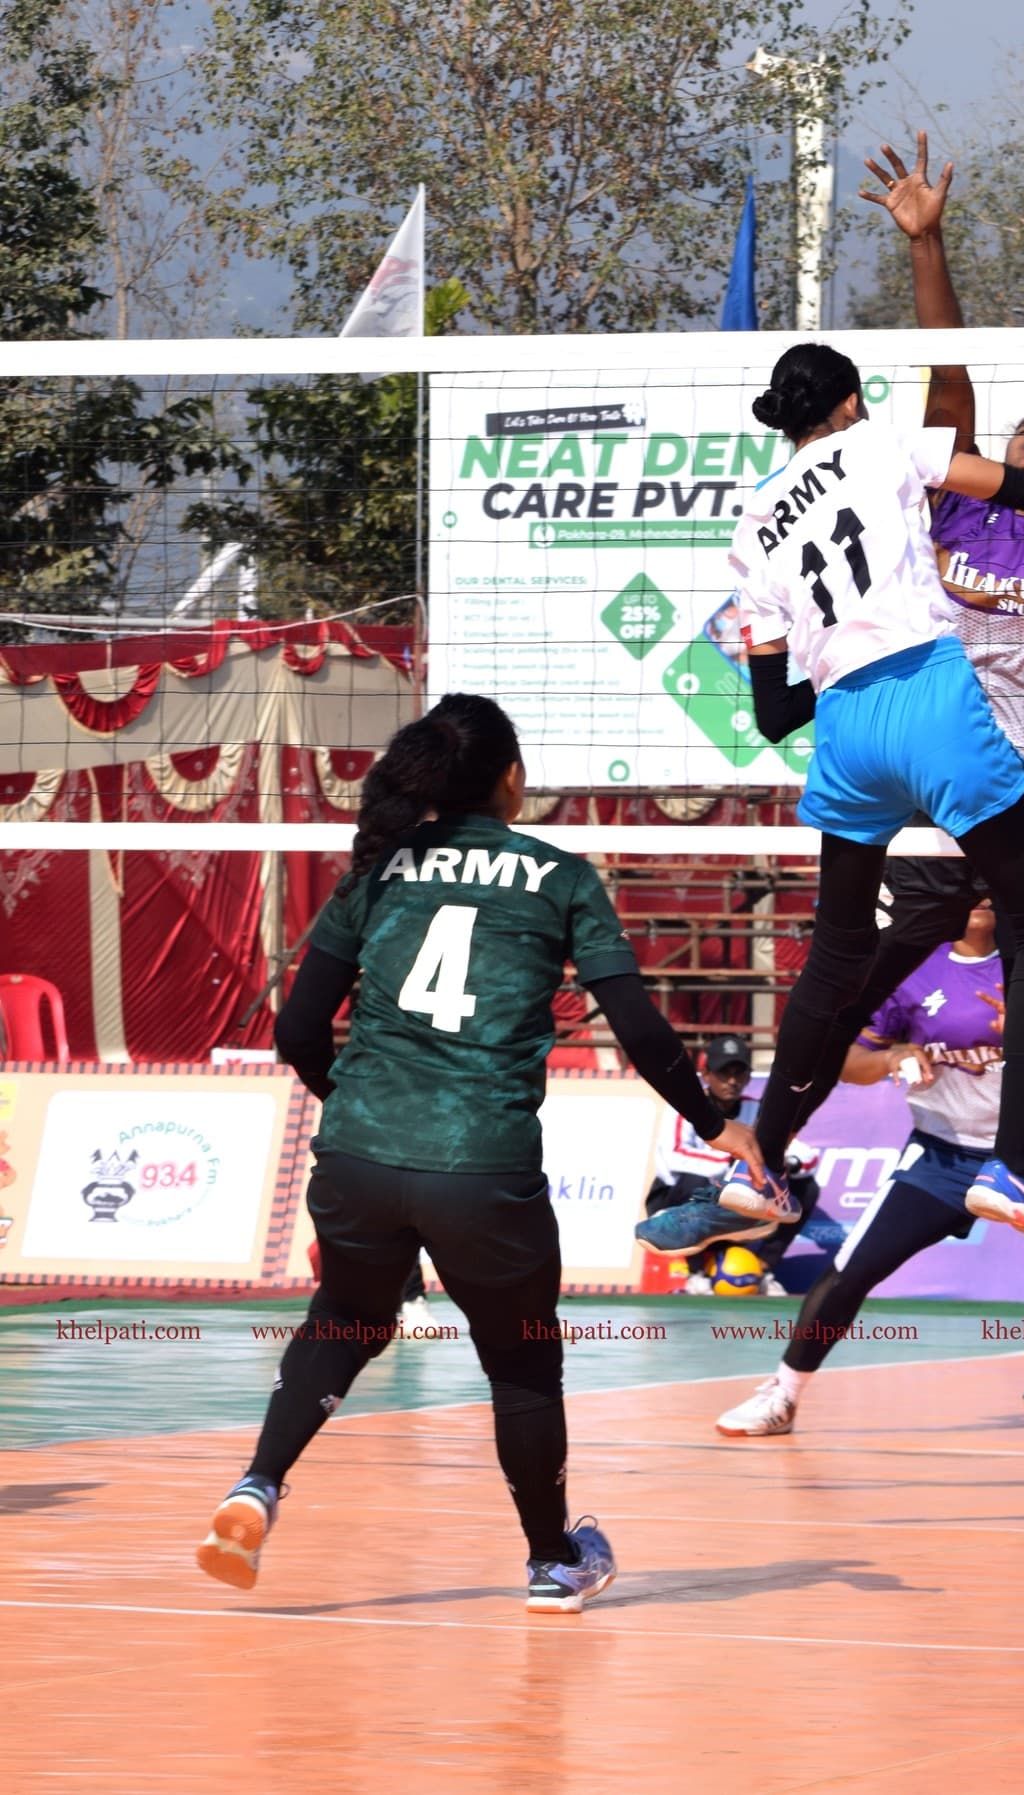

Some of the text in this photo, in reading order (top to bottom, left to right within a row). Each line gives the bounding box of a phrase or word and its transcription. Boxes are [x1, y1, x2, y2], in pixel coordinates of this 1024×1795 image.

[459, 432, 797, 479] NEAT DEN
[482, 480, 743, 519] CARE PVT.
[757, 449, 847, 560] ARMY
[455, 576, 479, 585] OUR
[483, 576, 526, 585] DENTAL
[800, 507, 872, 628] 11
[620, 605, 661, 622] 25%
[620, 624, 656, 639] OFF
[380, 848, 559, 893] ARMY
[398, 905, 478, 1033] 4
[119, 1121, 212, 1153] Annapurna
[141, 1160, 198, 1189] 93.4
